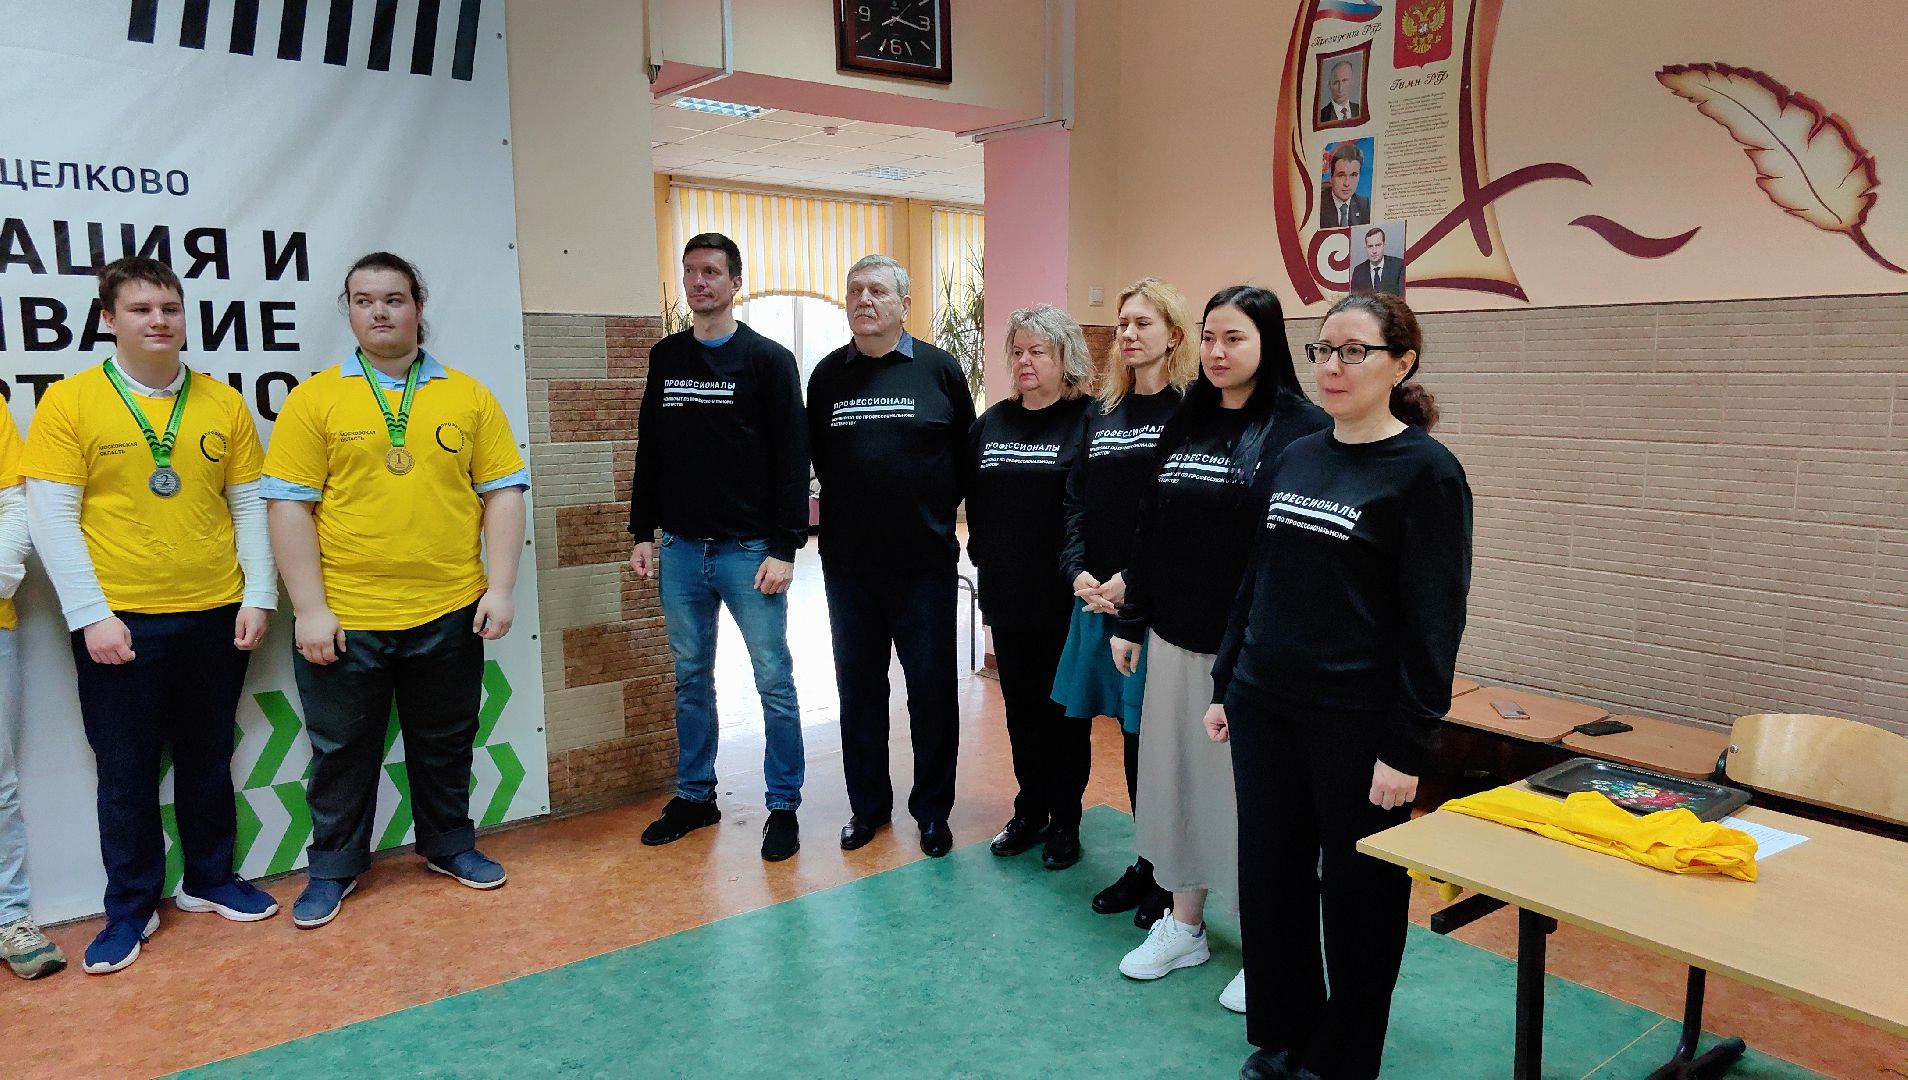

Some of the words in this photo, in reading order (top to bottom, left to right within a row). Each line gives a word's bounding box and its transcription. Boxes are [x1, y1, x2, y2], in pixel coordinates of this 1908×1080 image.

[859, 6, 871, 22] 9
[918, 15, 931, 32] 3
[1362, 22, 1383, 39] РФ
[890, 39, 903, 55] 6
[1389, 77, 1421, 91] Гимн
[1423, 70, 1449, 86] РФ
[262, 230, 310, 282] И
[833, 397, 915, 410] ПРОФЕССИОНАЛЫ
[396, 453, 402, 465] 1
[160, 474, 170, 487] 2
